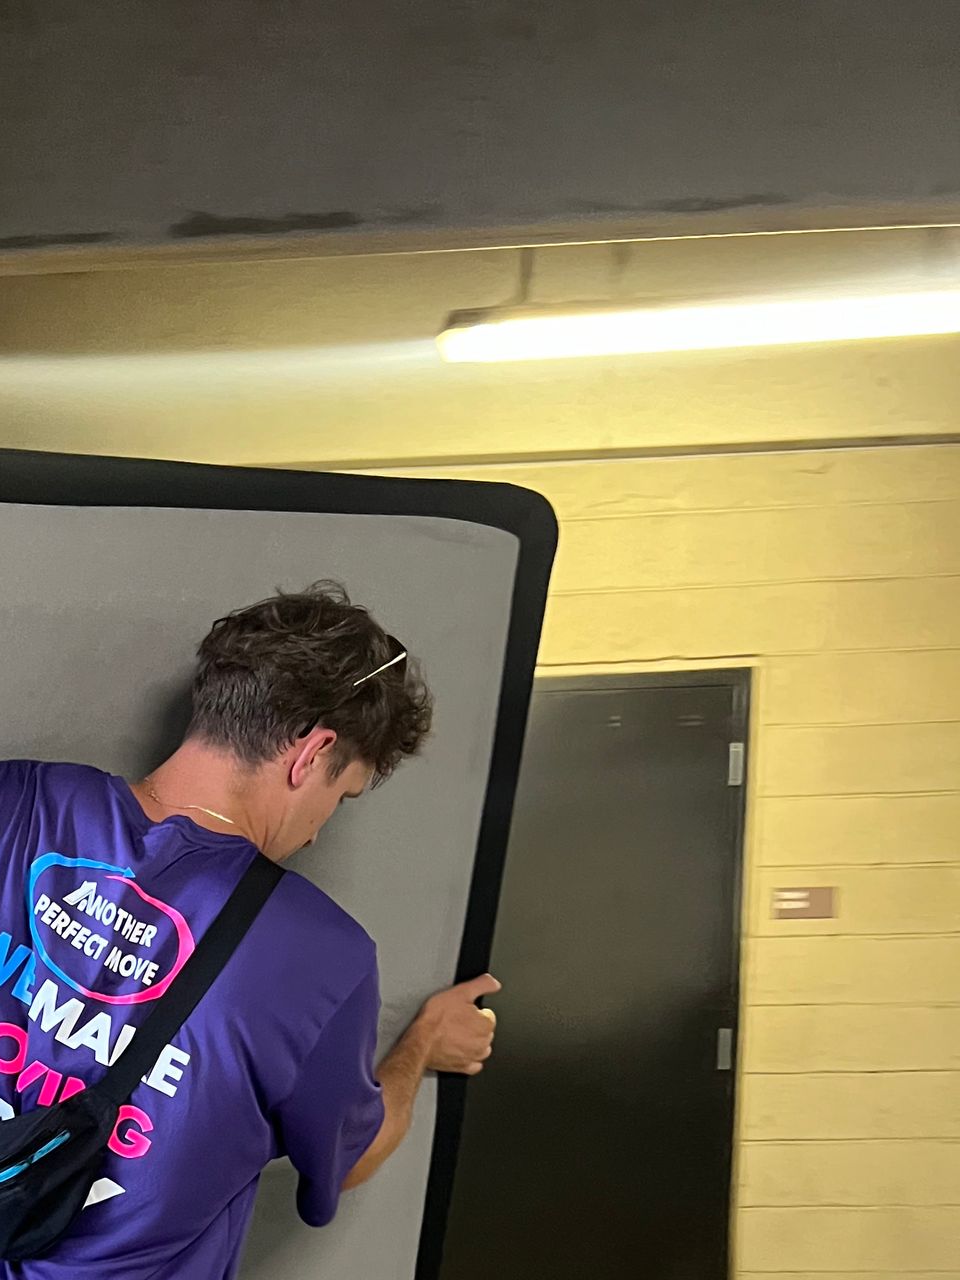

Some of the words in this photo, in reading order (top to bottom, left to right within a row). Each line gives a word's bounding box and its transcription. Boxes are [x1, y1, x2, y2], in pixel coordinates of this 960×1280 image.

[33, 893, 109, 961] PERFECT
[103, 946, 160, 986] MOVE
[62, 880, 158, 948] ANOTHER
